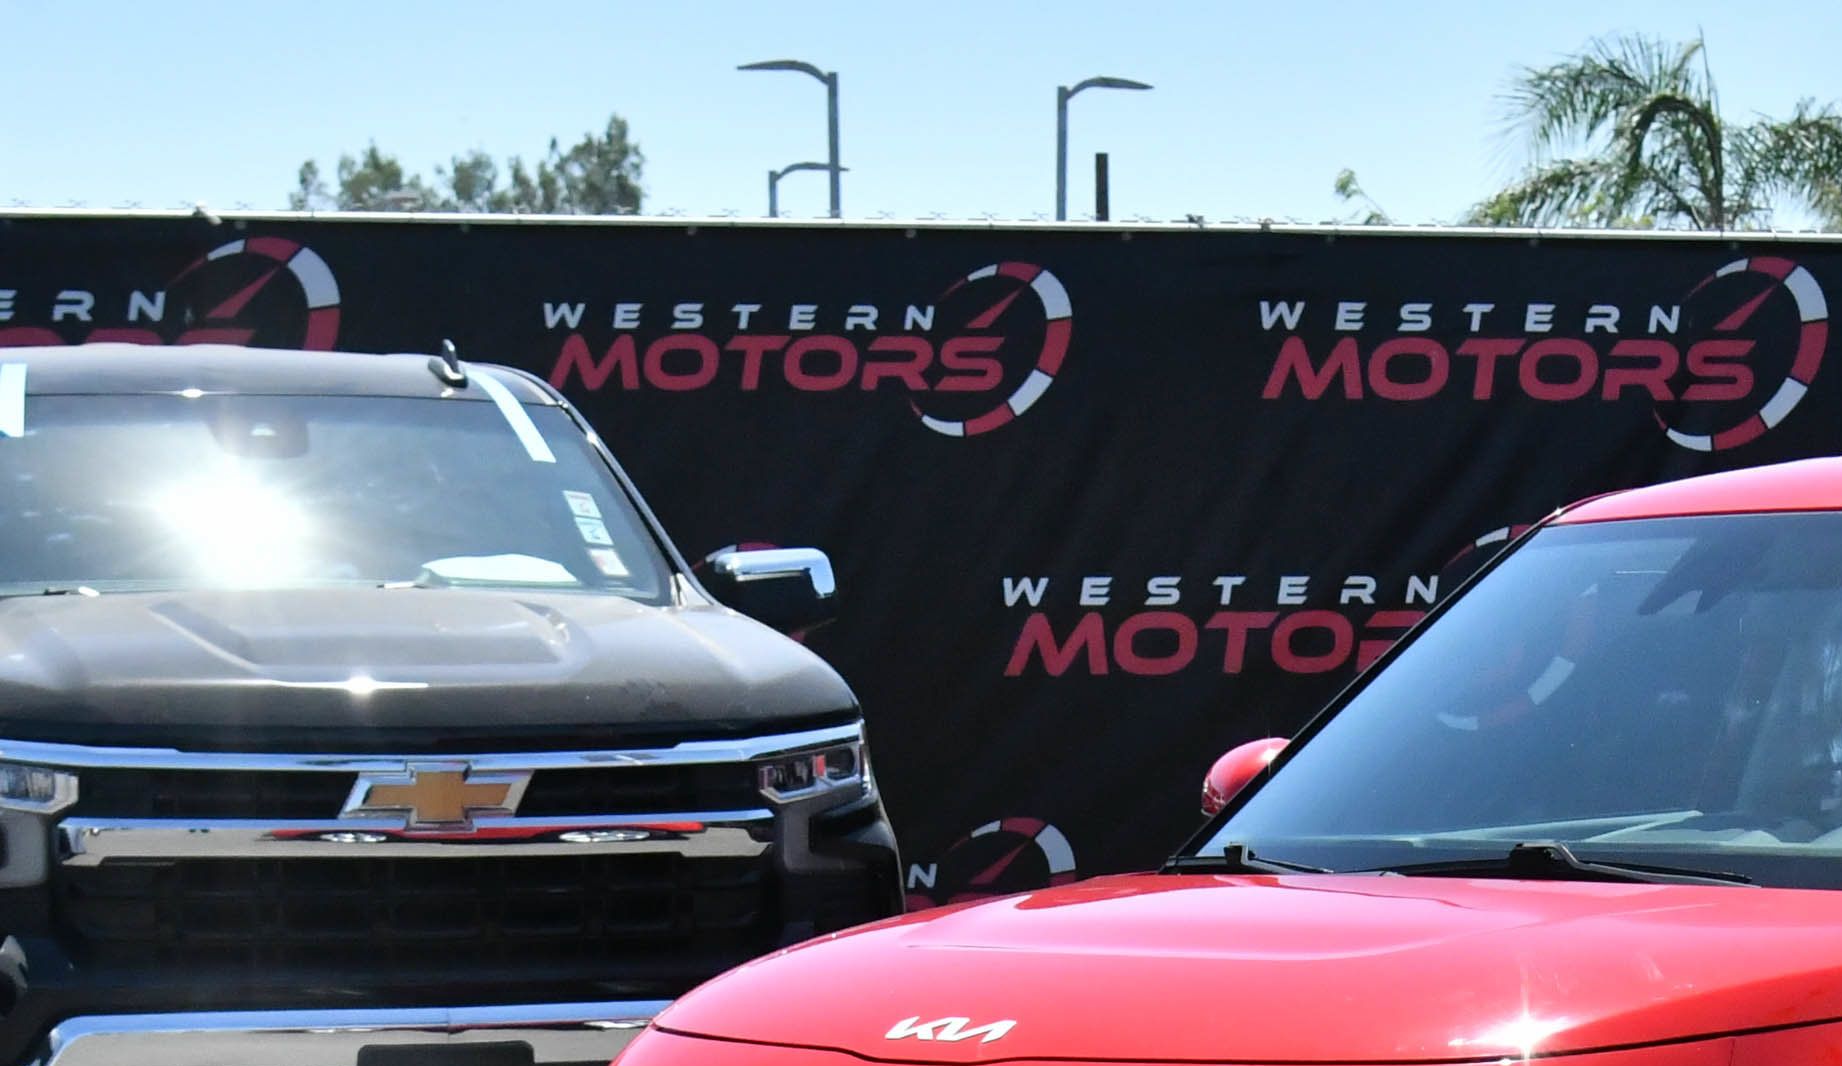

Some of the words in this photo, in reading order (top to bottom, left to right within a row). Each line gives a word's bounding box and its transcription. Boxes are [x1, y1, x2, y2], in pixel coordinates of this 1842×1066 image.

[543, 302, 934, 331] WESTERN
[1259, 300, 1681, 334] WESTERN
[547, 334, 1004, 392] MOTORS
[1261, 336, 1756, 400] MOTORS
[1002, 575, 1439, 607] WESTERN
[885, 1015, 1017, 1044] KIA
